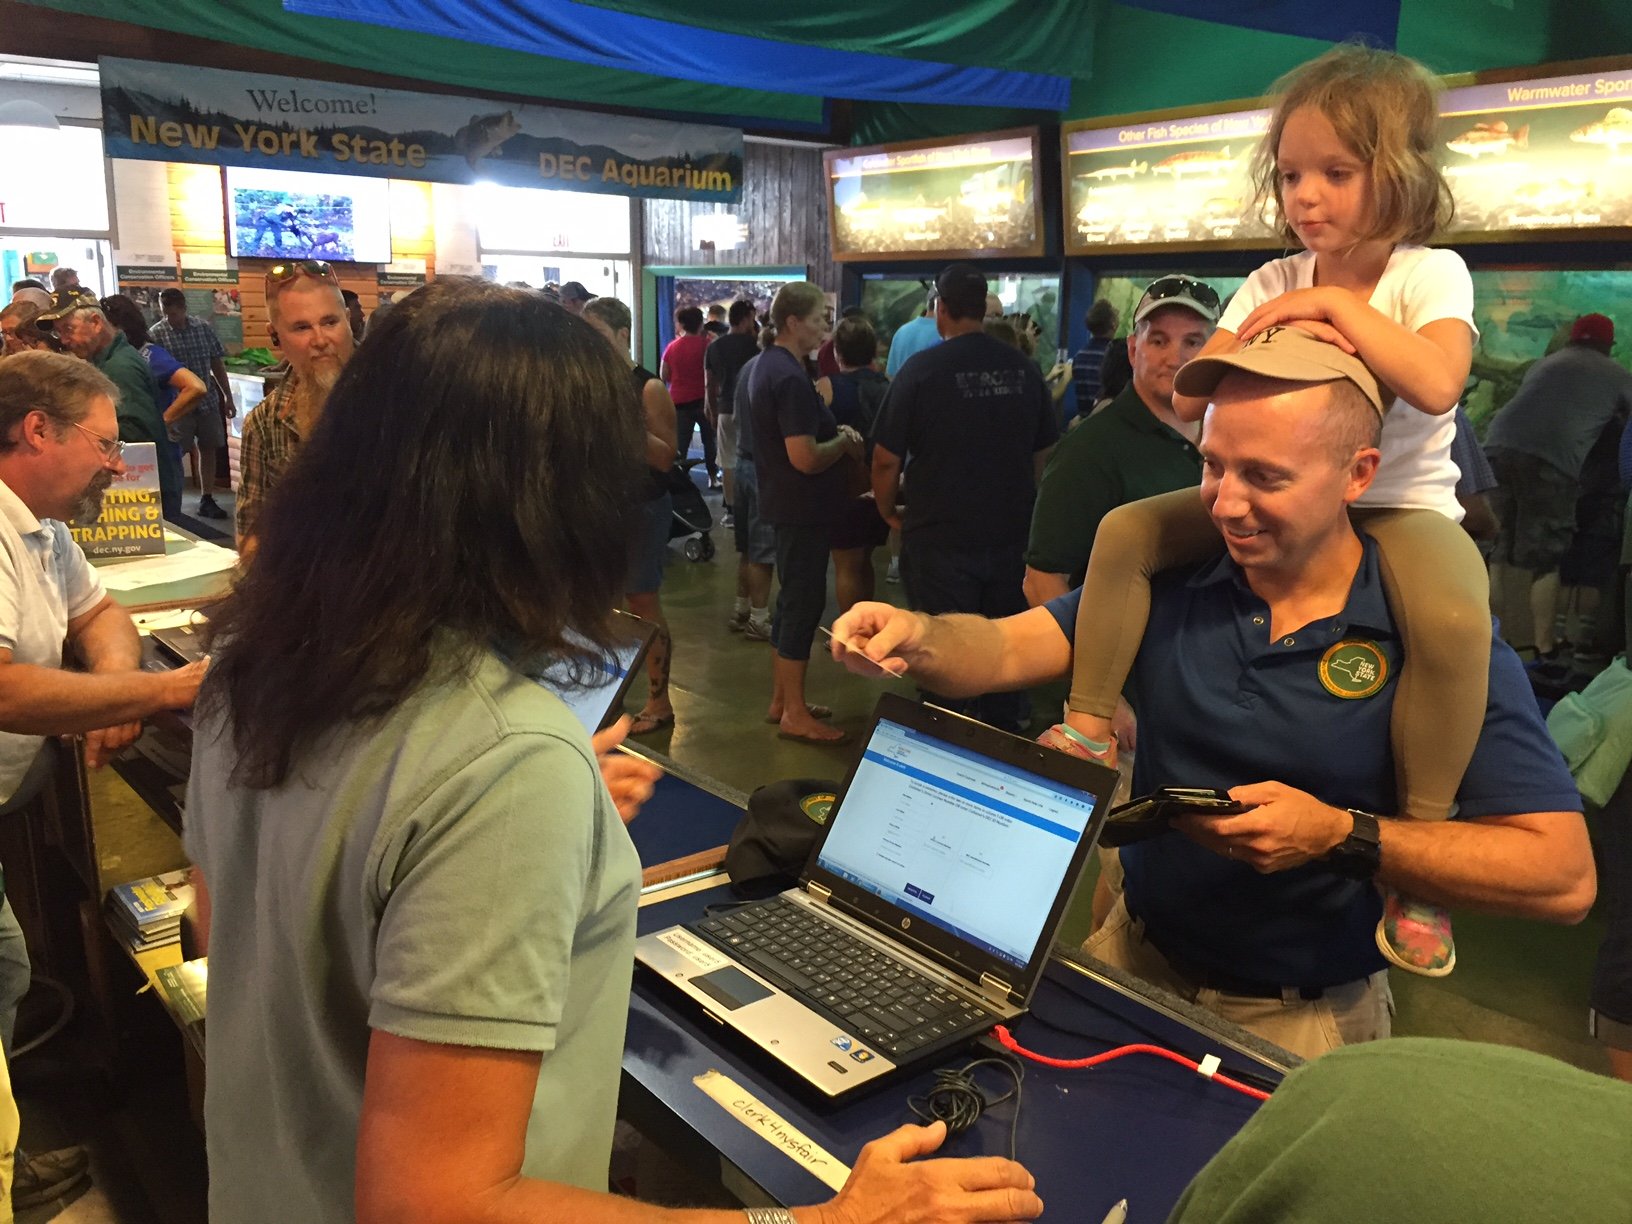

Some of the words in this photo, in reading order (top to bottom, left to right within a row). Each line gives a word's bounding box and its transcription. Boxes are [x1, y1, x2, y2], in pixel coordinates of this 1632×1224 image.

[246, 88, 377, 115] Welcome!
[1507, 83, 1591, 102] Warmwater
[1118, 129, 1145, 143] Other
[1147, 127, 1168, 139] Fish
[1169, 123, 1210, 139] Species
[1211, 118, 1224, 131] of
[129, 114, 221, 151] New
[234, 122, 320, 158] York
[330, 132, 428, 169] State
[539, 151, 592, 181] DEC
[601, 157, 733, 192] Aquarium
[102, 488, 156, 505] TING,
[96, 506, 141, 523] HING
[145, 505, 159, 521] &
[69, 523, 161, 543] TRAPPING
[93, 545, 141, 554] dec.ny.gov
[1358, 666, 1375, 676] YORK
[1360, 661, 1375, 670] NEW
[1355, 671, 1376, 681] STATE
